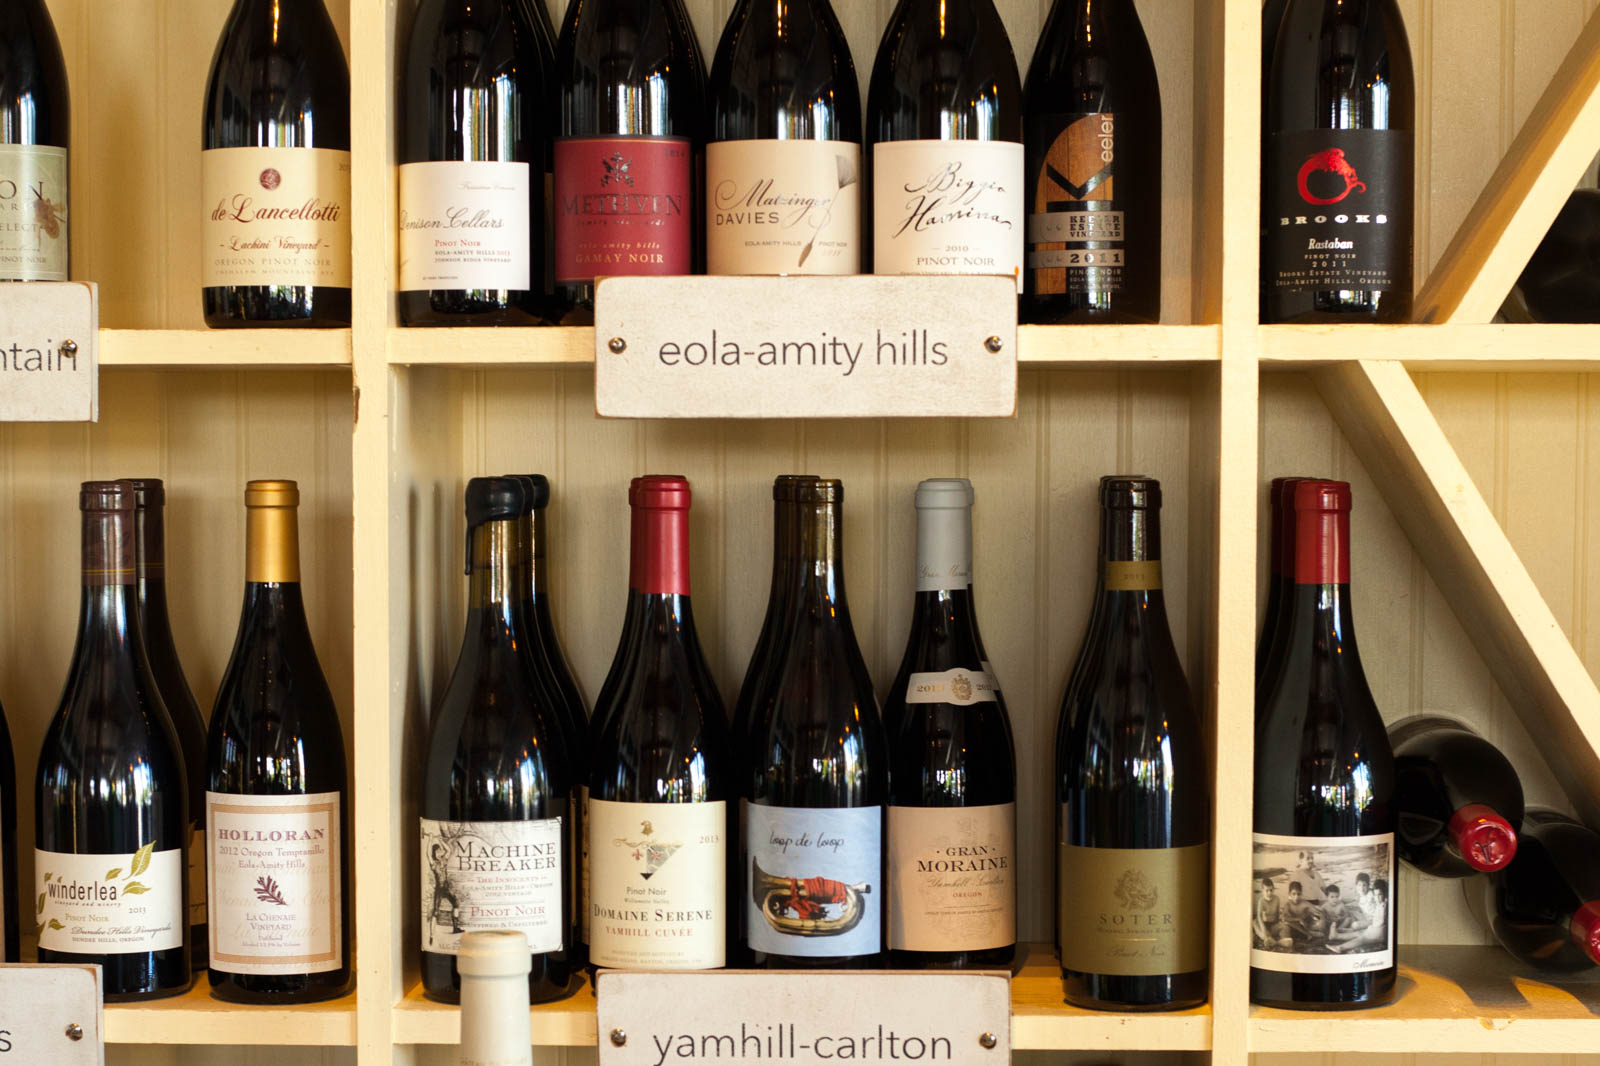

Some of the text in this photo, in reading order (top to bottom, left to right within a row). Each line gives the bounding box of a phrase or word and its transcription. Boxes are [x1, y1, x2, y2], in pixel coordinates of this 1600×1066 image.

[211, 194, 341, 223] de Lancellotti
[561, 195, 682, 216] METHVEN
[443, 207, 504, 229] Cellars
[716, 211, 779, 226] DAVIES
[1070, 215, 1120, 223] KEELER
[1281, 214, 1387, 226] BROOKS
[1070, 223, 1120, 231] ESTATE
[945, 245, 969, 253] 2010
[1308, 238, 1353, 250] Rastaban
[576, 254, 664, 264] GAMAY NOIR
[917, 257, 995, 266] PINOT NOIR
[1070, 253, 1120, 263] 2011
[659, 329, 948, 376] eola-amity hills
[218, 828, 324, 842] HOLLORAN
[795, 832, 812, 847] de
[219, 844, 325, 858] 2012 Oregon Tempranillo
[456, 842, 556, 858] MACHINE
[946, 846, 988, 857] GRAN
[458, 856, 556, 872] BREAKER
[918, 857, 1008, 873] MORAINE
[48, 880, 117, 901] winderlea
[626, 886, 667, 896] Pinot Noir
[65, 913, 110, 922] PINOT NOIR
[471, 905, 546, 917] PINOT NOIR
[594, 904, 712, 922] DOMAINE SERENE
[1099, 913, 1173, 925] SOTER
[605, 926, 693, 937] YAMHILL CUVÉE
[653, 1023, 952, 1066] yamhill-carlton
